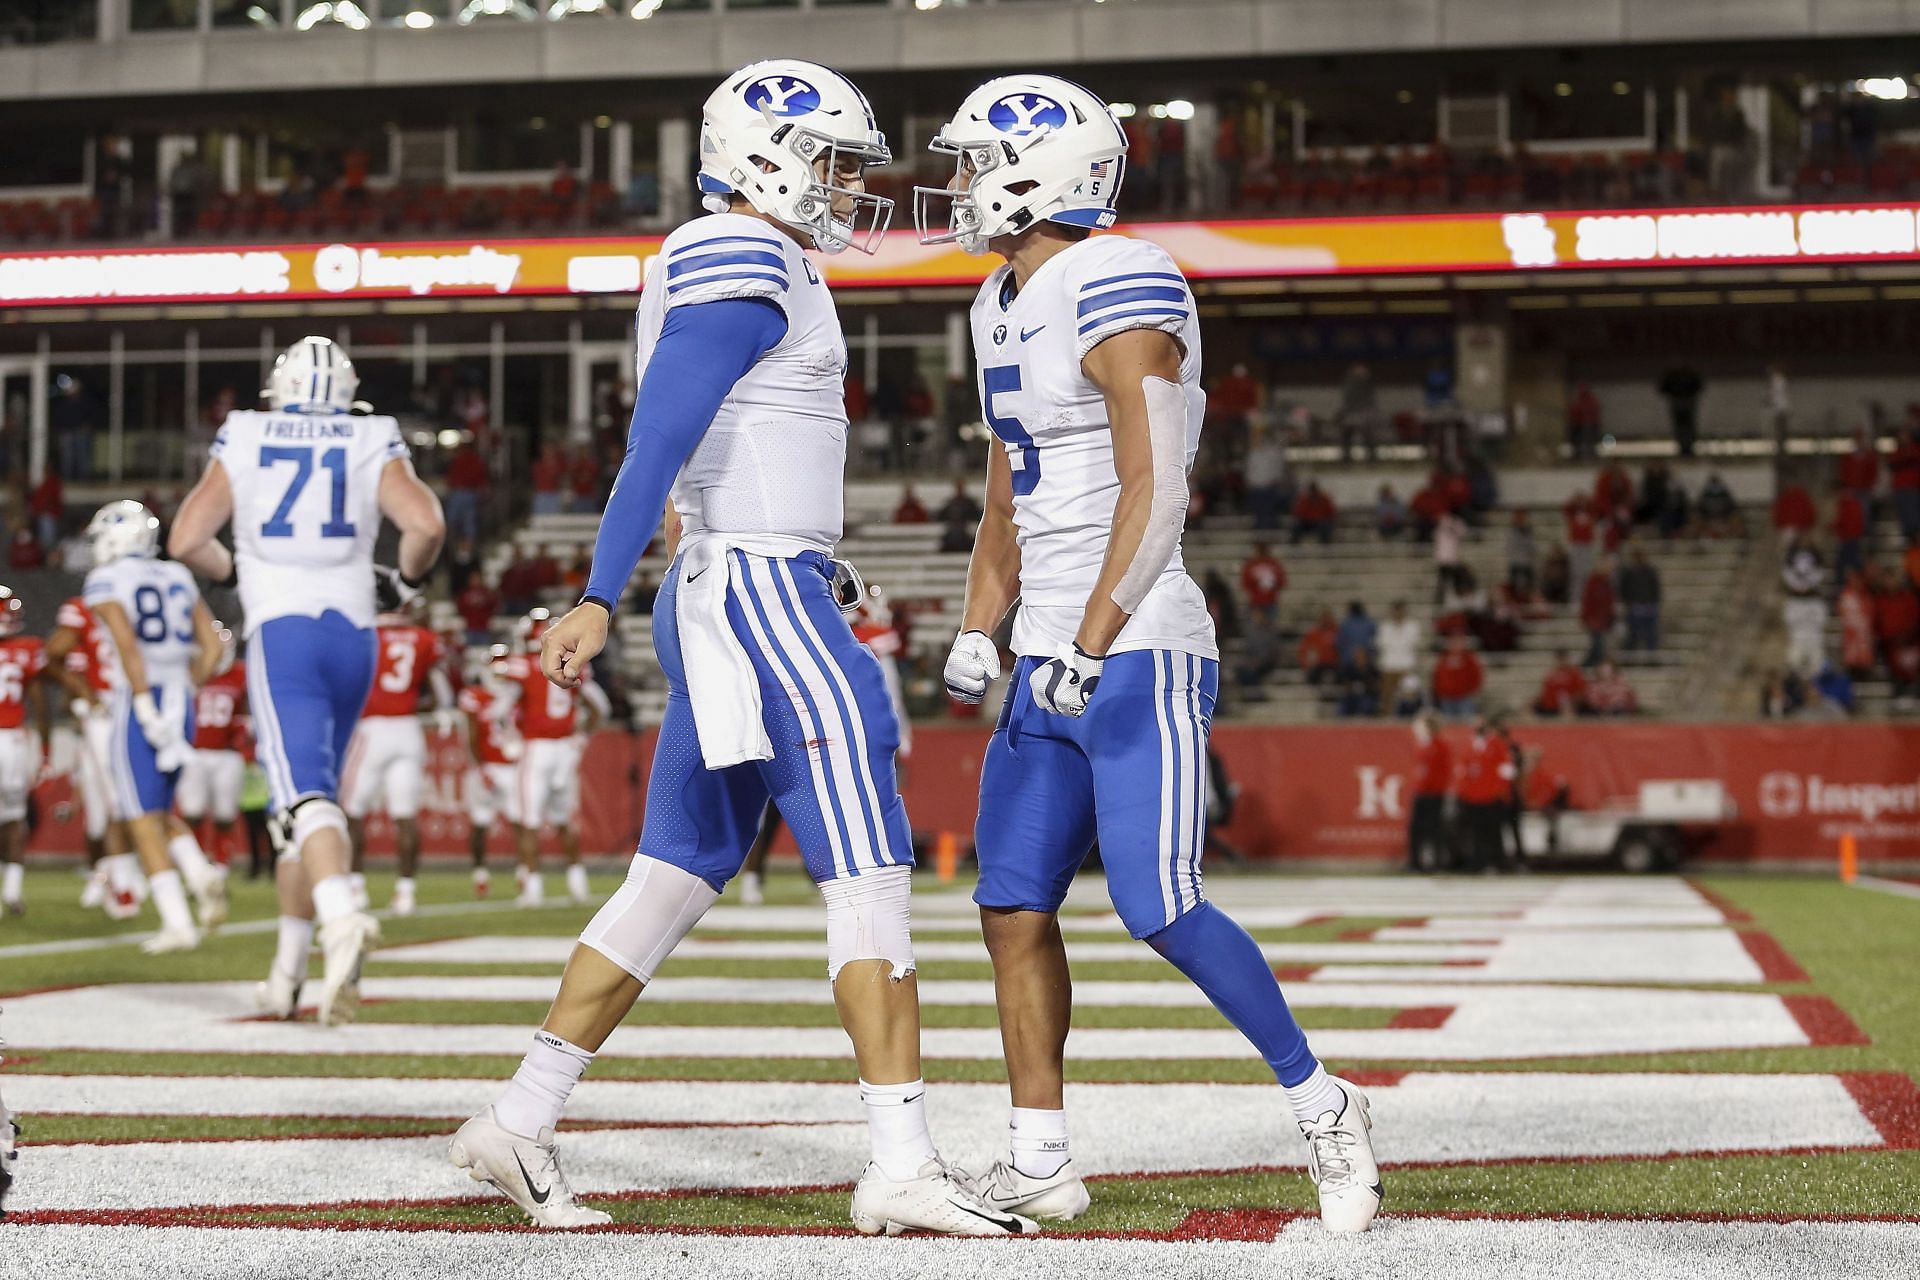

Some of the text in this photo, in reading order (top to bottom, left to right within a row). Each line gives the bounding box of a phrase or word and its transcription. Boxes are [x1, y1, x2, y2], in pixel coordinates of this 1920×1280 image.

[758, 77, 811, 113] Y
[999, 95, 1056, 131] Y
[1091, 181, 1101, 196] 5
[265, 420, 354, 438] FREELAND
[983, 364, 1042, 496] 5
[259, 446, 356, 538] 71
[135, 584, 194, 643] 83
[380, 643, 416, 692] 3
[1043, 1141, 1069, 1150] NIKE
